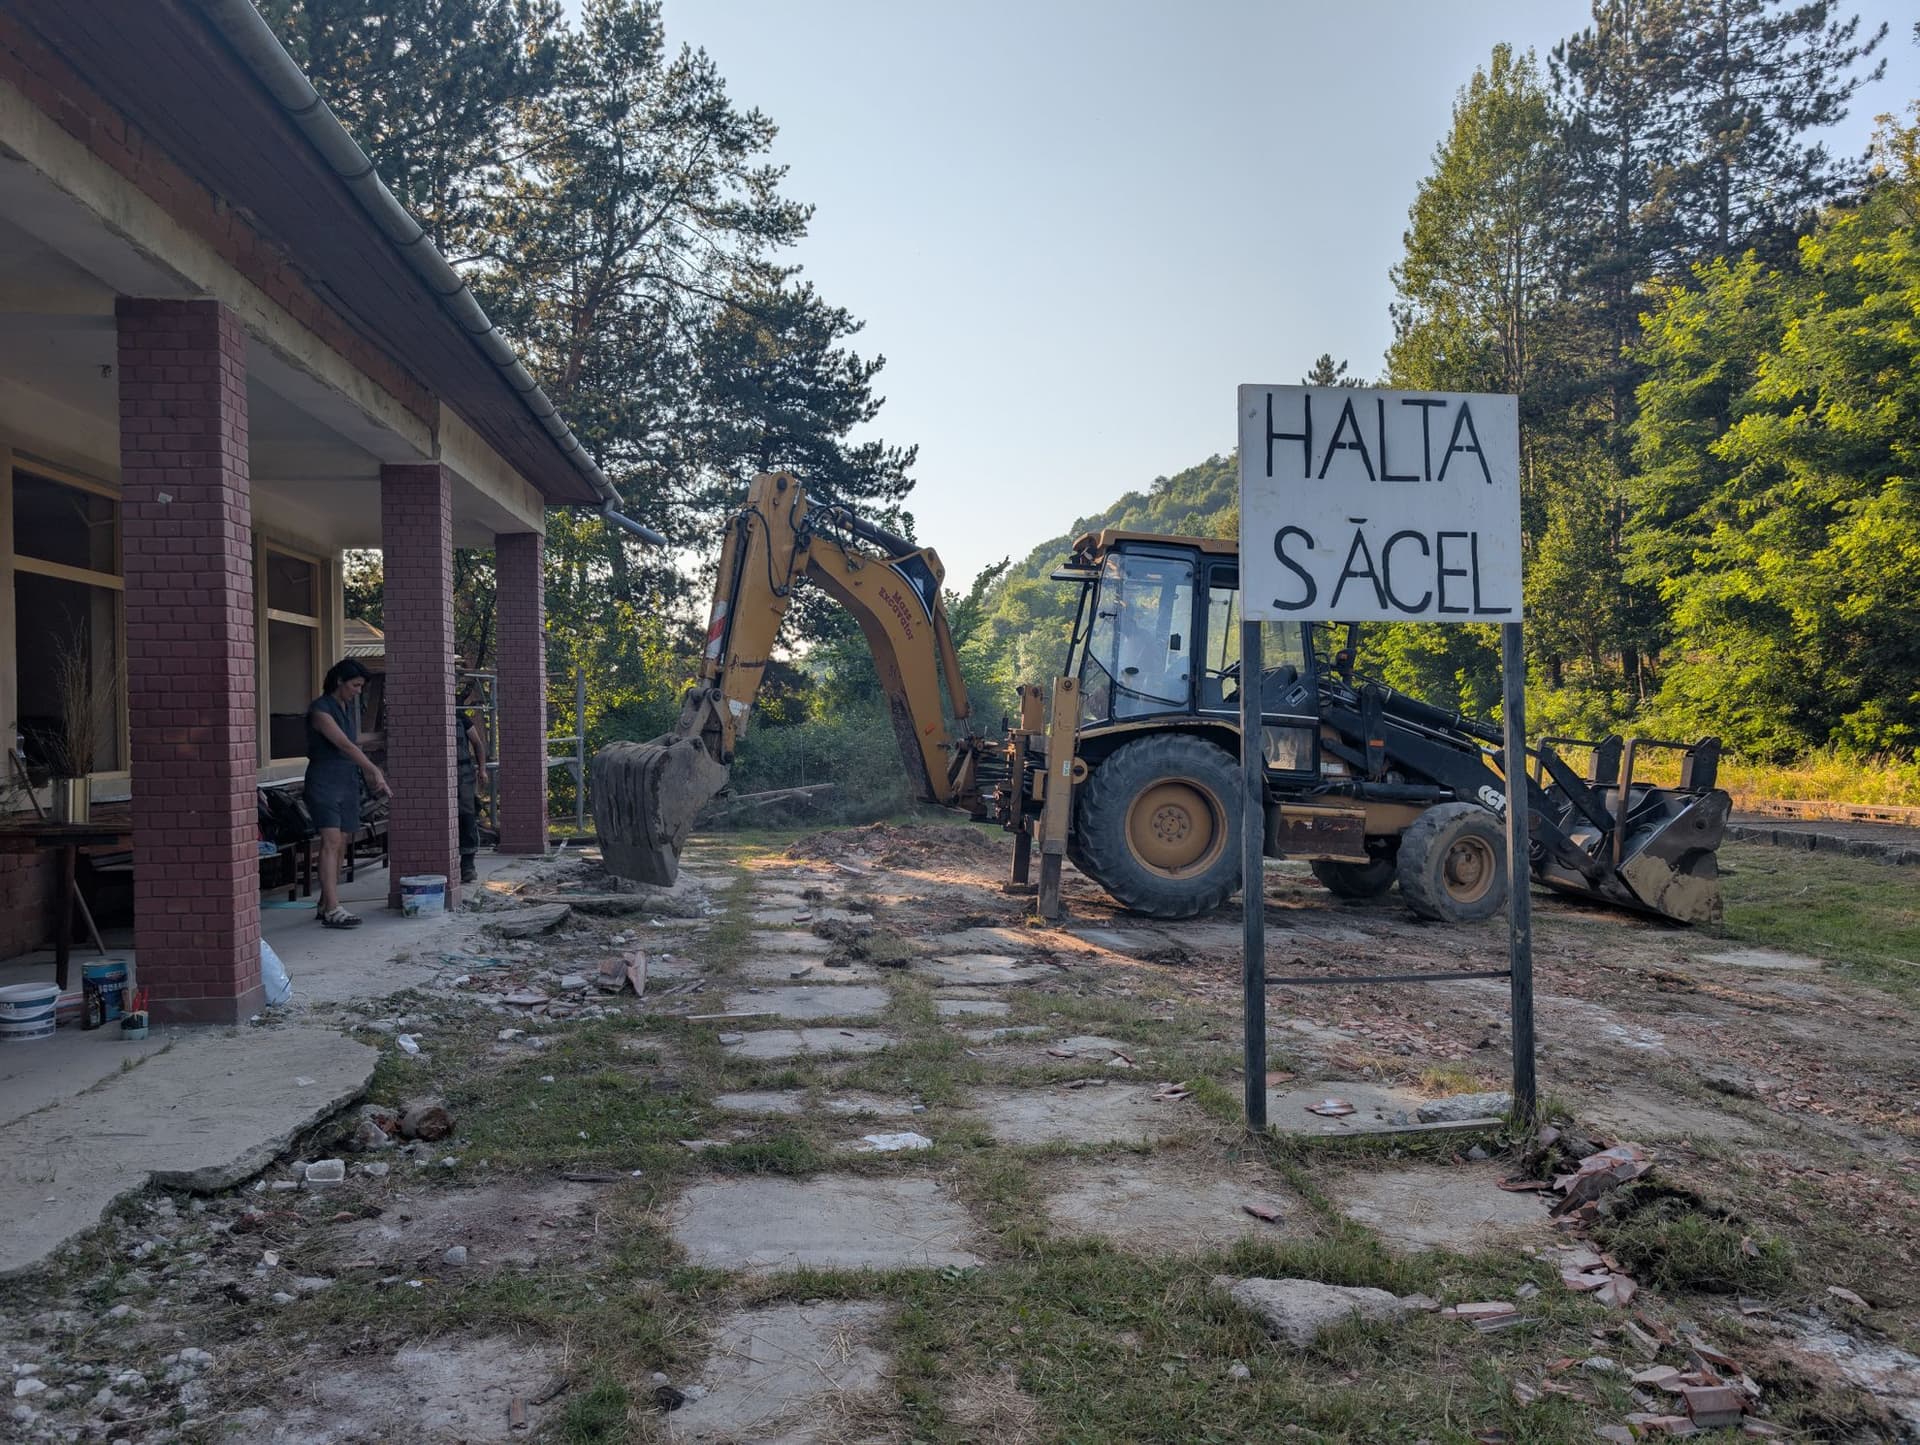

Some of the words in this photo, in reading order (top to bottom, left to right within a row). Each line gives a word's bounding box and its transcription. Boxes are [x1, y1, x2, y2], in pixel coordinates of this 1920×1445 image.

[1266, 393, 1492, 484] HALTA
[1272, 518, 1512, 614] SĂCEL
[879, 587, 913, 640] Excavator
